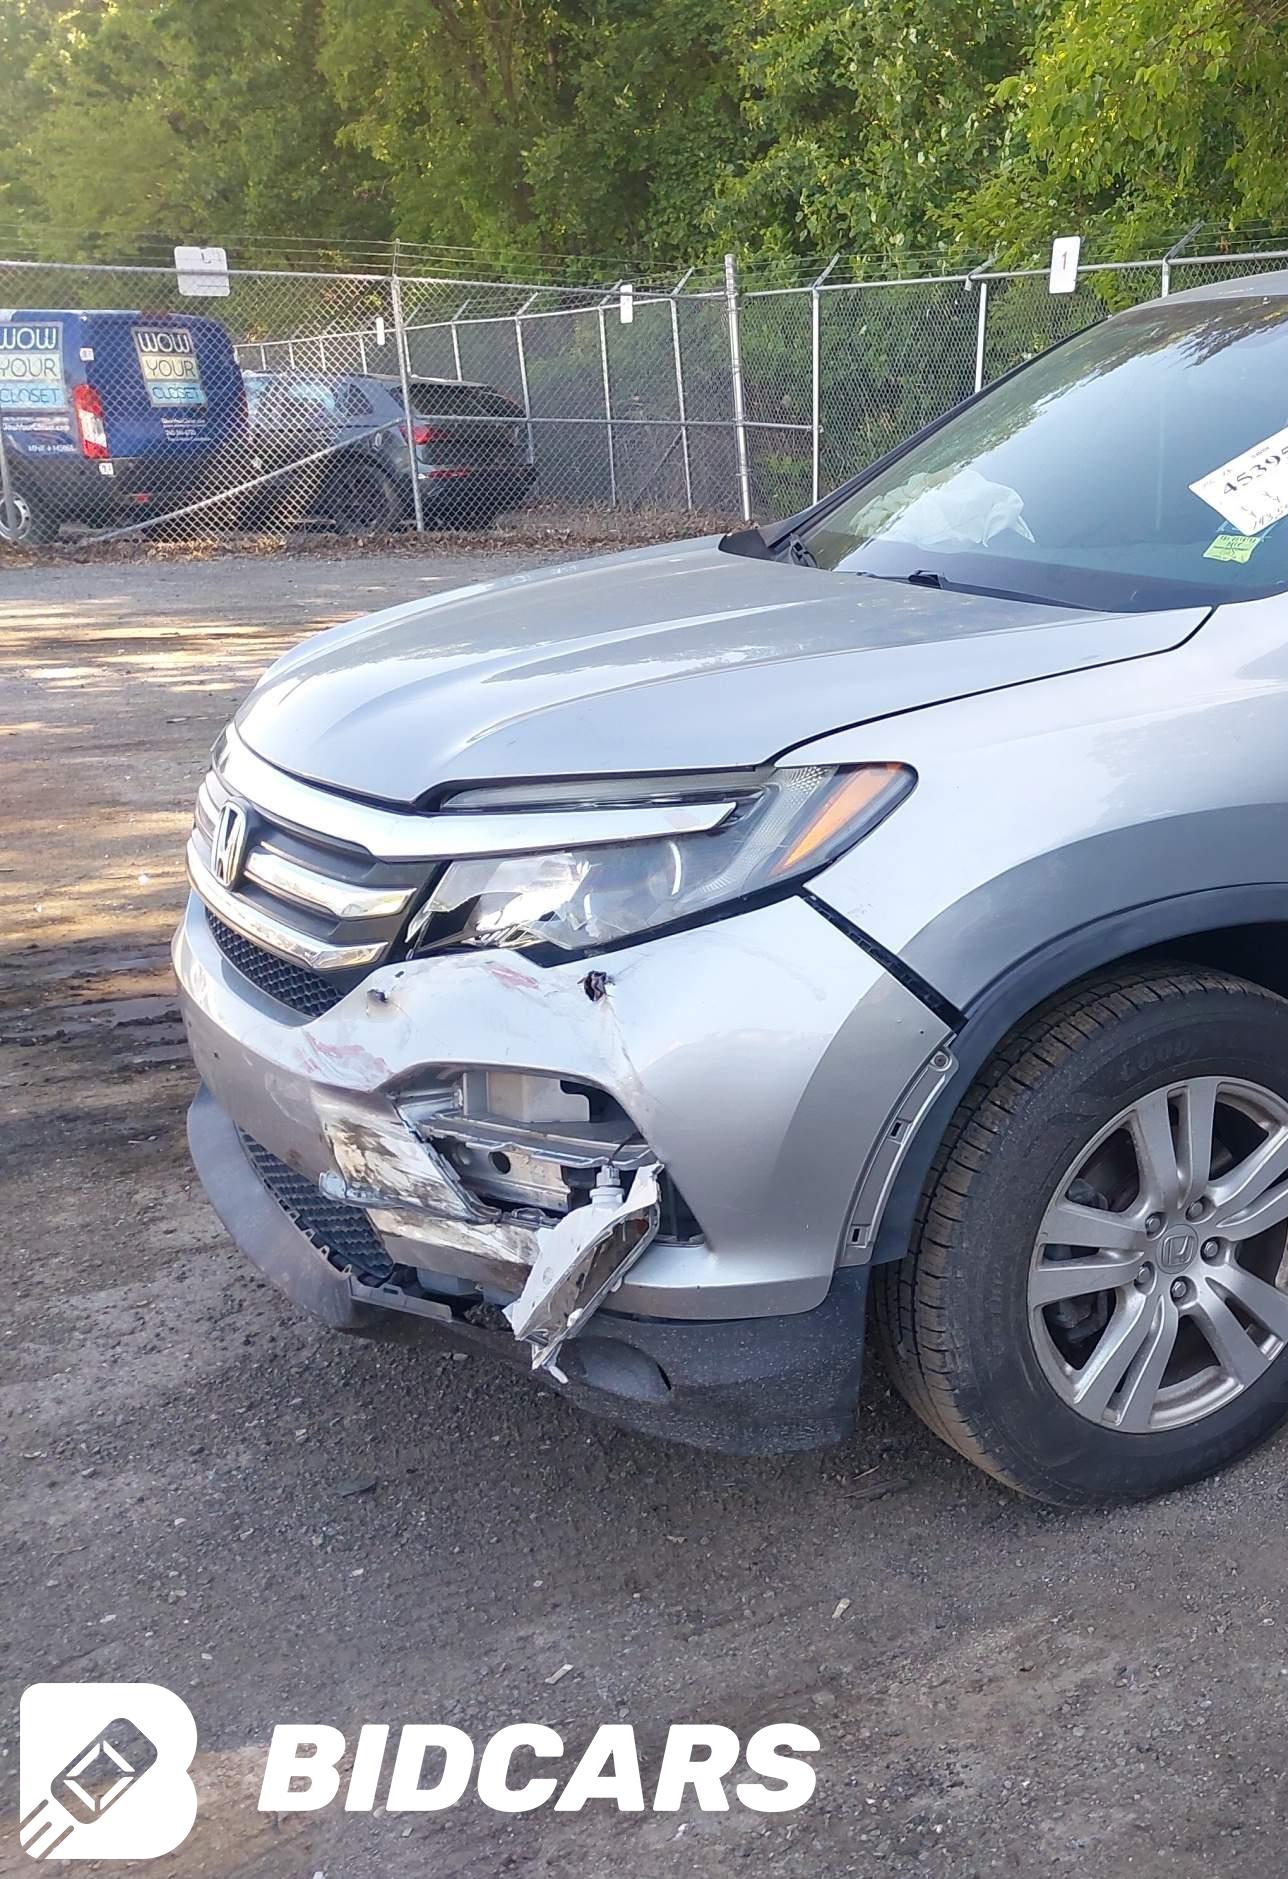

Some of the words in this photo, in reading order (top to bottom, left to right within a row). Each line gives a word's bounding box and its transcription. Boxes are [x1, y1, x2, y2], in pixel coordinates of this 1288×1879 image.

[1061, 250, 1069, 270] 1
[0, 327, 56, 349] WOW
[138, 332, 189, 352] WOW
[145, 359, 196, 378] YOUR
[0, 387, 60, 403] CLOSET
[152, 387, 200, 400] CLOSET
